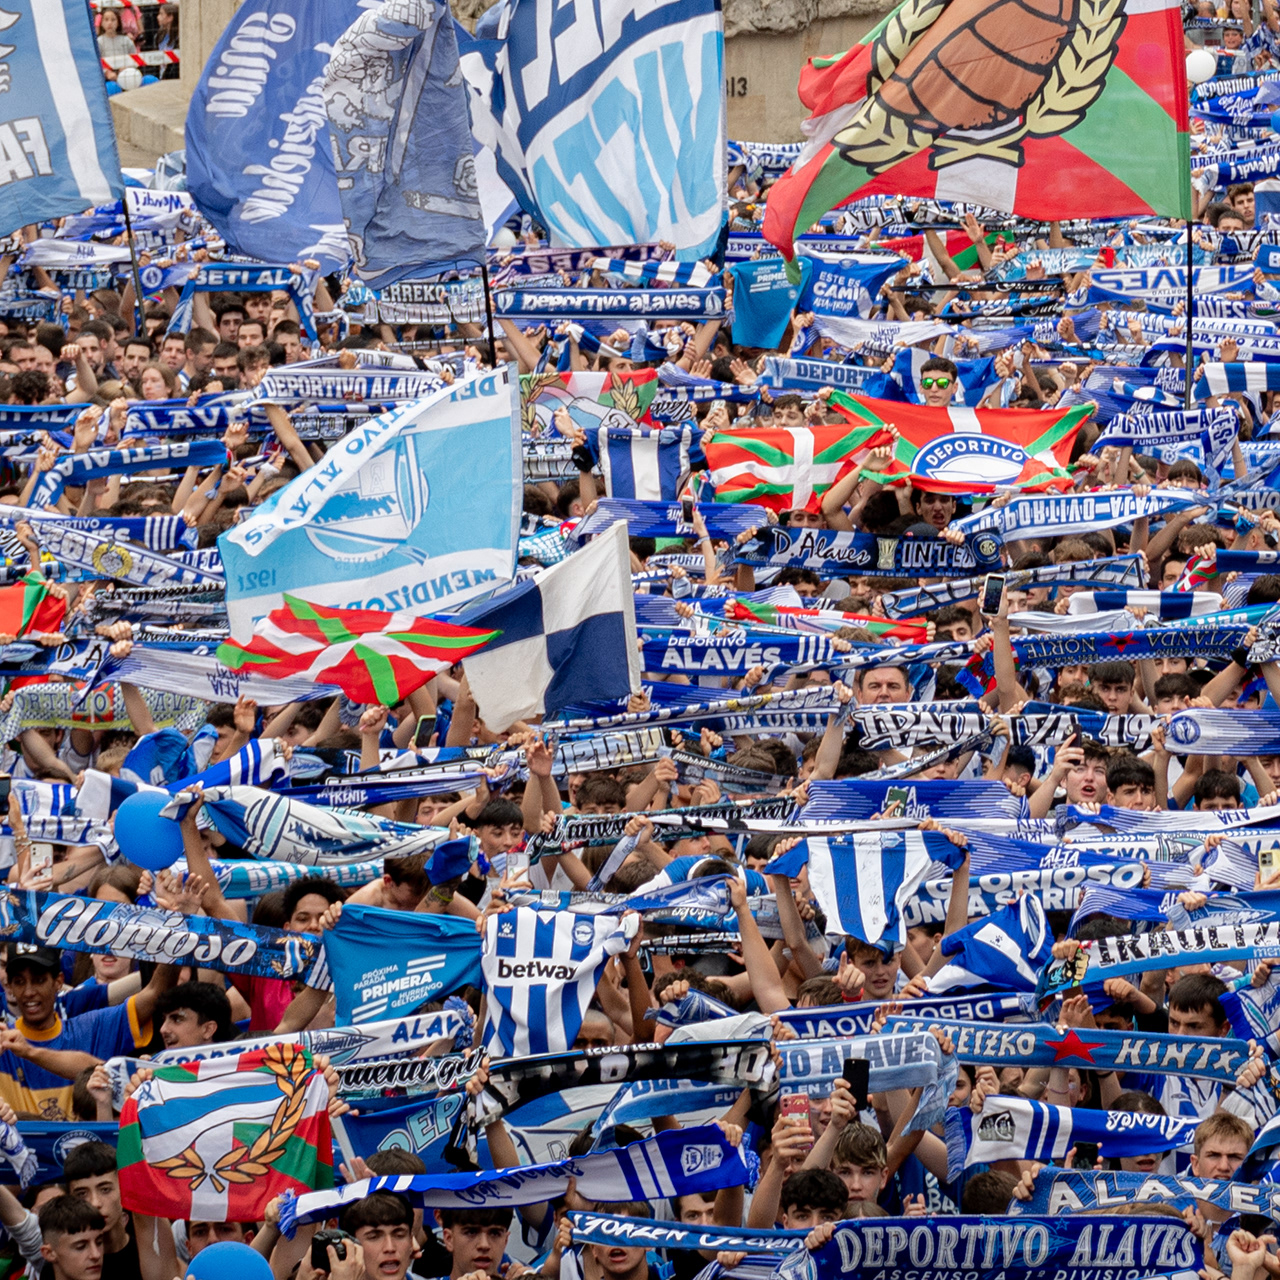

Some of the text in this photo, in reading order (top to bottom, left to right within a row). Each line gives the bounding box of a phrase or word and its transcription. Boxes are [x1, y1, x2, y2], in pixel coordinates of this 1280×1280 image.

[266, 377, 444, 399] DEPORTIVO ALAVES
[926, 439, 1022, 465] DEPORTIVO
[668, 636, 746, 647] DEPORTIVO
[662, 648, 780, 669] ALAVÉS
[362, 964, 399, 980] PRÓXIMA
[497, 958, 578, 980] betway
[354, 974, 385, 991] PARADA
[362, 972, 432, 1001] PRIMERA
[399, 982, 443, 1001] HURRENGO
[391, 991, 428, 1007] GELTOKIA
[822, 1034, 938, 1073] ALAVES
[837, 1224, 1196, 1271] DEPORTIVO ALAVES
